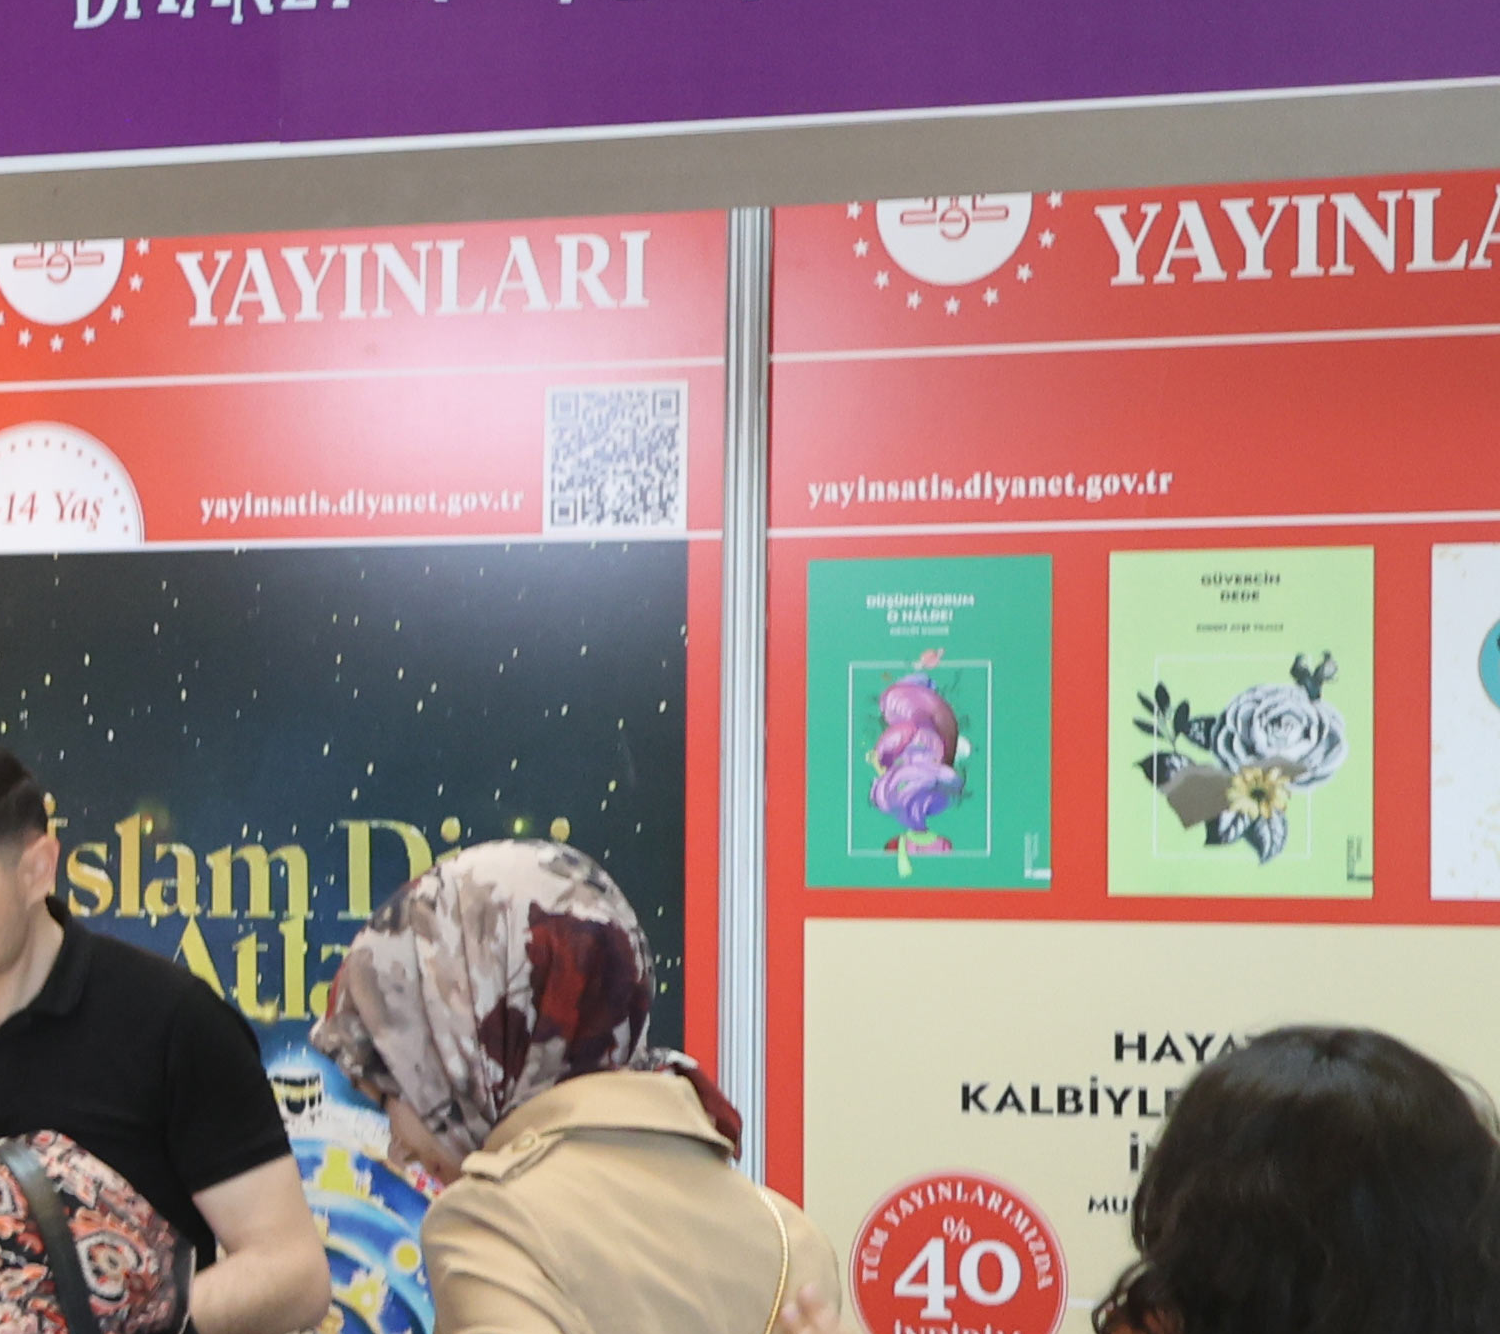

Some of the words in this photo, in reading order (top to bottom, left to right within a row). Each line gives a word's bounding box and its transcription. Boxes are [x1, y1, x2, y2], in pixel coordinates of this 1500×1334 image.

[175, 230, 651, 327] YAYINLARI
[54, 488, 103, 533] Yaş
[200, 487, 524, 524] yayinsatis.diyanet.gov.tr
[807, 470, 1173, 509] yayinsatis.diyanet.gov.tr
[893, 1236, 1022, 1320] 40
